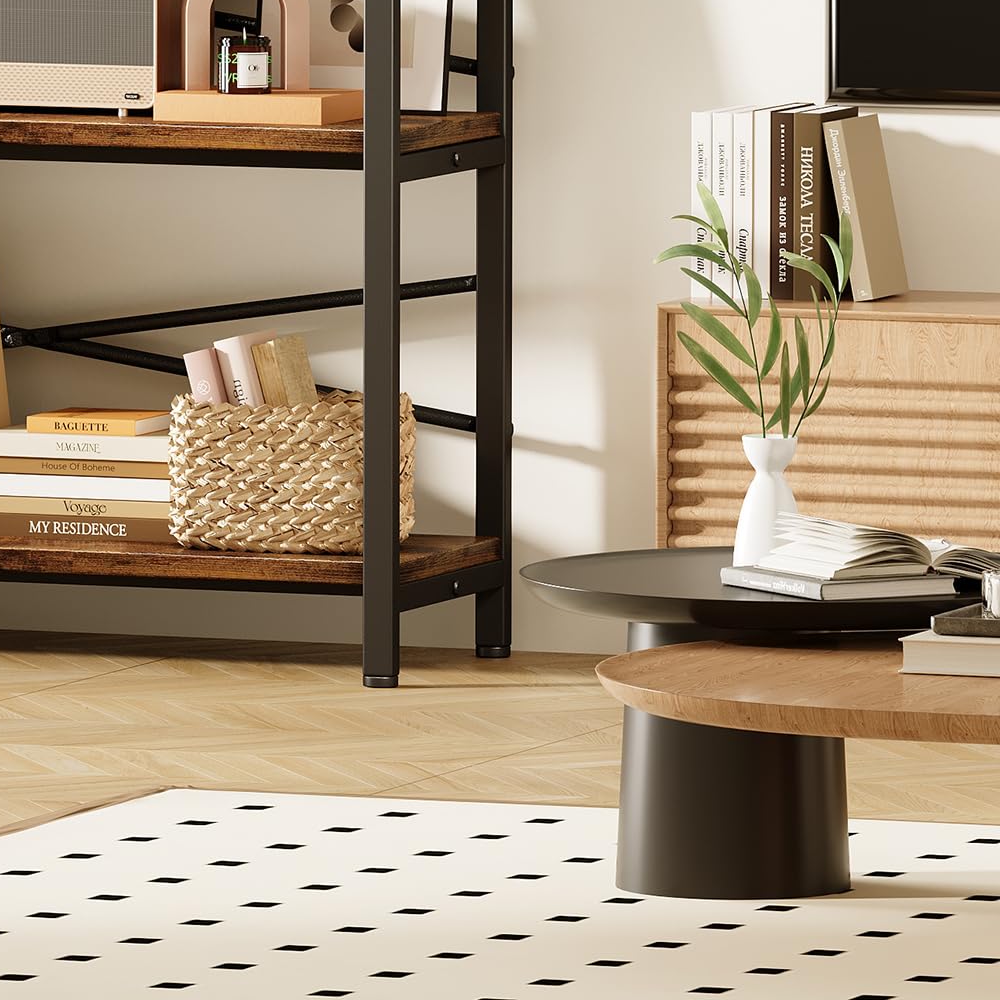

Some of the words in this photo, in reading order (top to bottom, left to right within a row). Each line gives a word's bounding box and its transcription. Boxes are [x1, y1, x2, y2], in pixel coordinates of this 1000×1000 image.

[800, 146, 814, 208] НИКОЛА
[778, 196, 787, 229] замок
[778, 232, 787, 245] из
[54, 421, 109, 432] BAGUETTE
[56, 441, 101, 454] MAGAZINE
[41, 462, 67, 471] House
[69, 462, 81, 471] Of
[82, 462, 116, 473] Boheme
[63, 500, 107, 516] Voyage
[29, 520, 51, 534] MY
[53, 521, 128, 537] RESIDENCE
